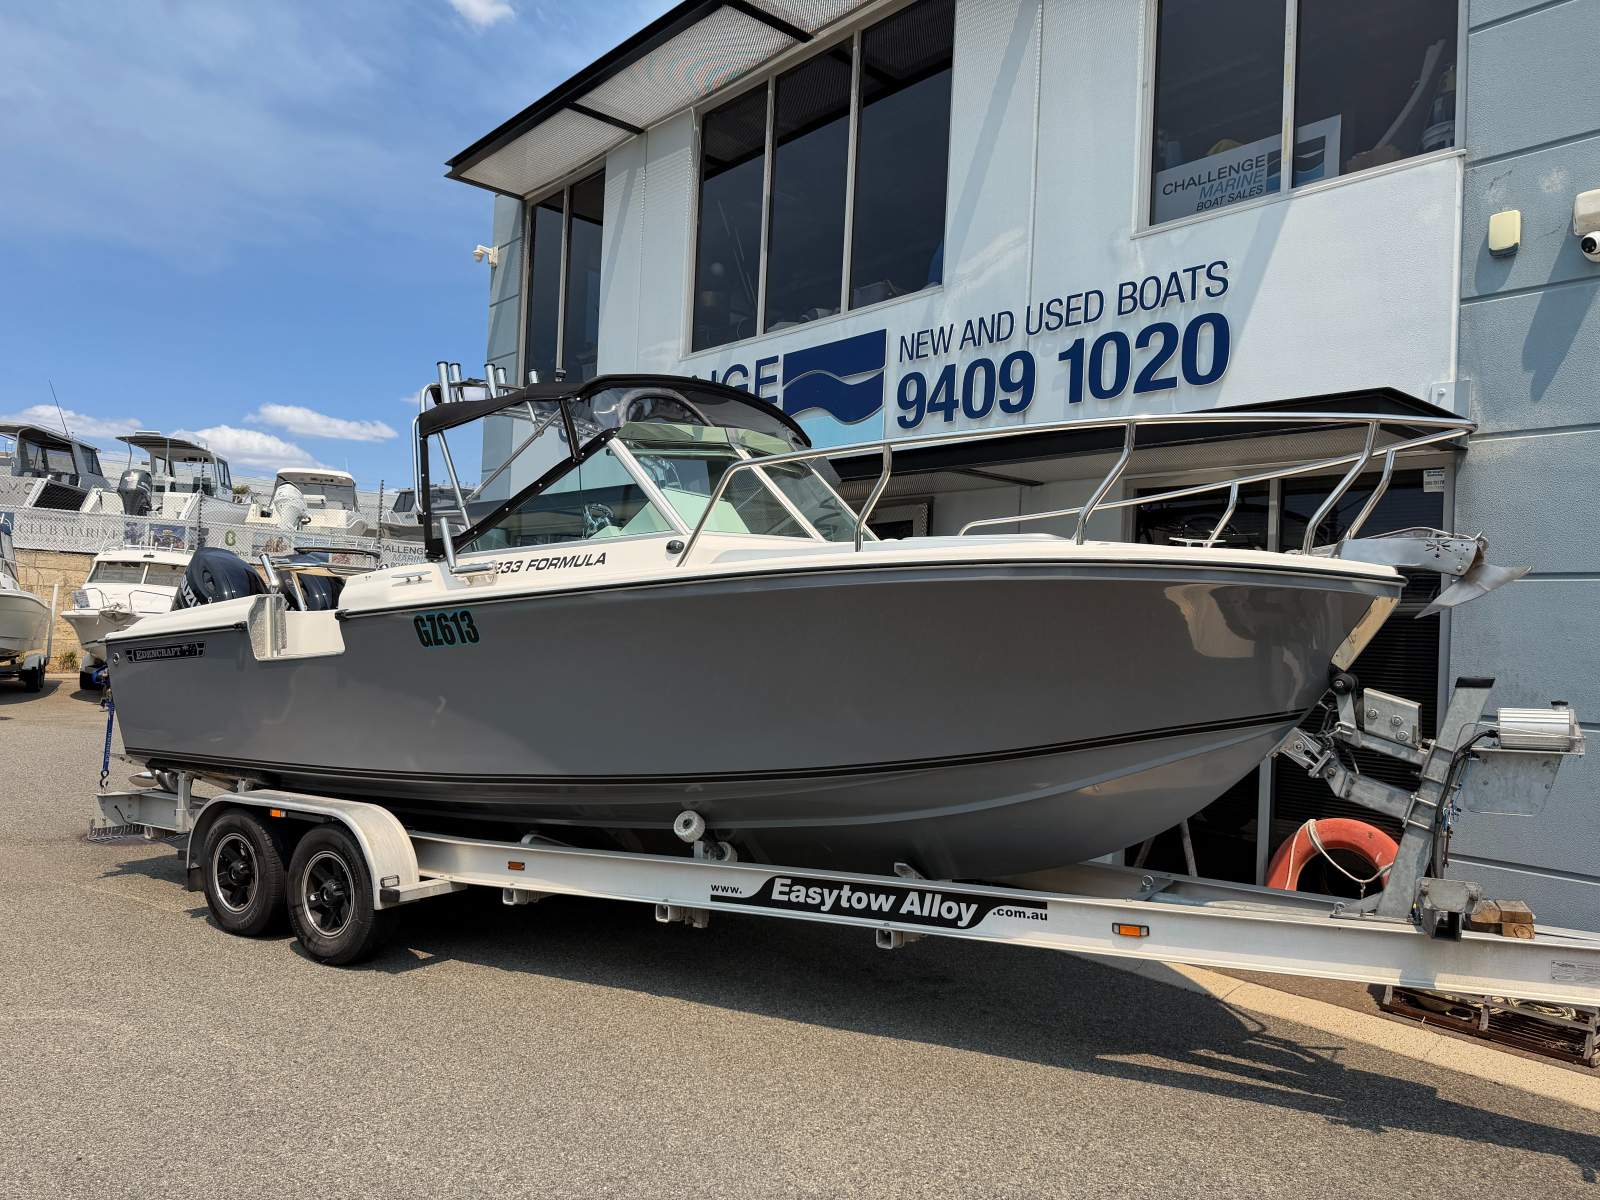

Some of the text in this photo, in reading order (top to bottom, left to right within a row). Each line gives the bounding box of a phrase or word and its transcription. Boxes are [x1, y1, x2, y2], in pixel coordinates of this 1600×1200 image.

[1162, 154, 1266, 196] CHALLENGE
[1199, 168, 1265, 199] MARINE
[1196, 184, 1264, 212] BOAT SALES
[898, 260, 1229, 363] NEW AND USED BOATS
[896, 312, 1231, 429] 9409 1020
[525, 552, 607, 572] FORMULA
[413, 610, 480, 648] GZ613
[135, 647, 181, 660] EDENCRAFT
[771, 877, 897, 913] Easytow
[900, 891, 978, 927] Alloy
[993, 908, 1048, 921] .com.au
